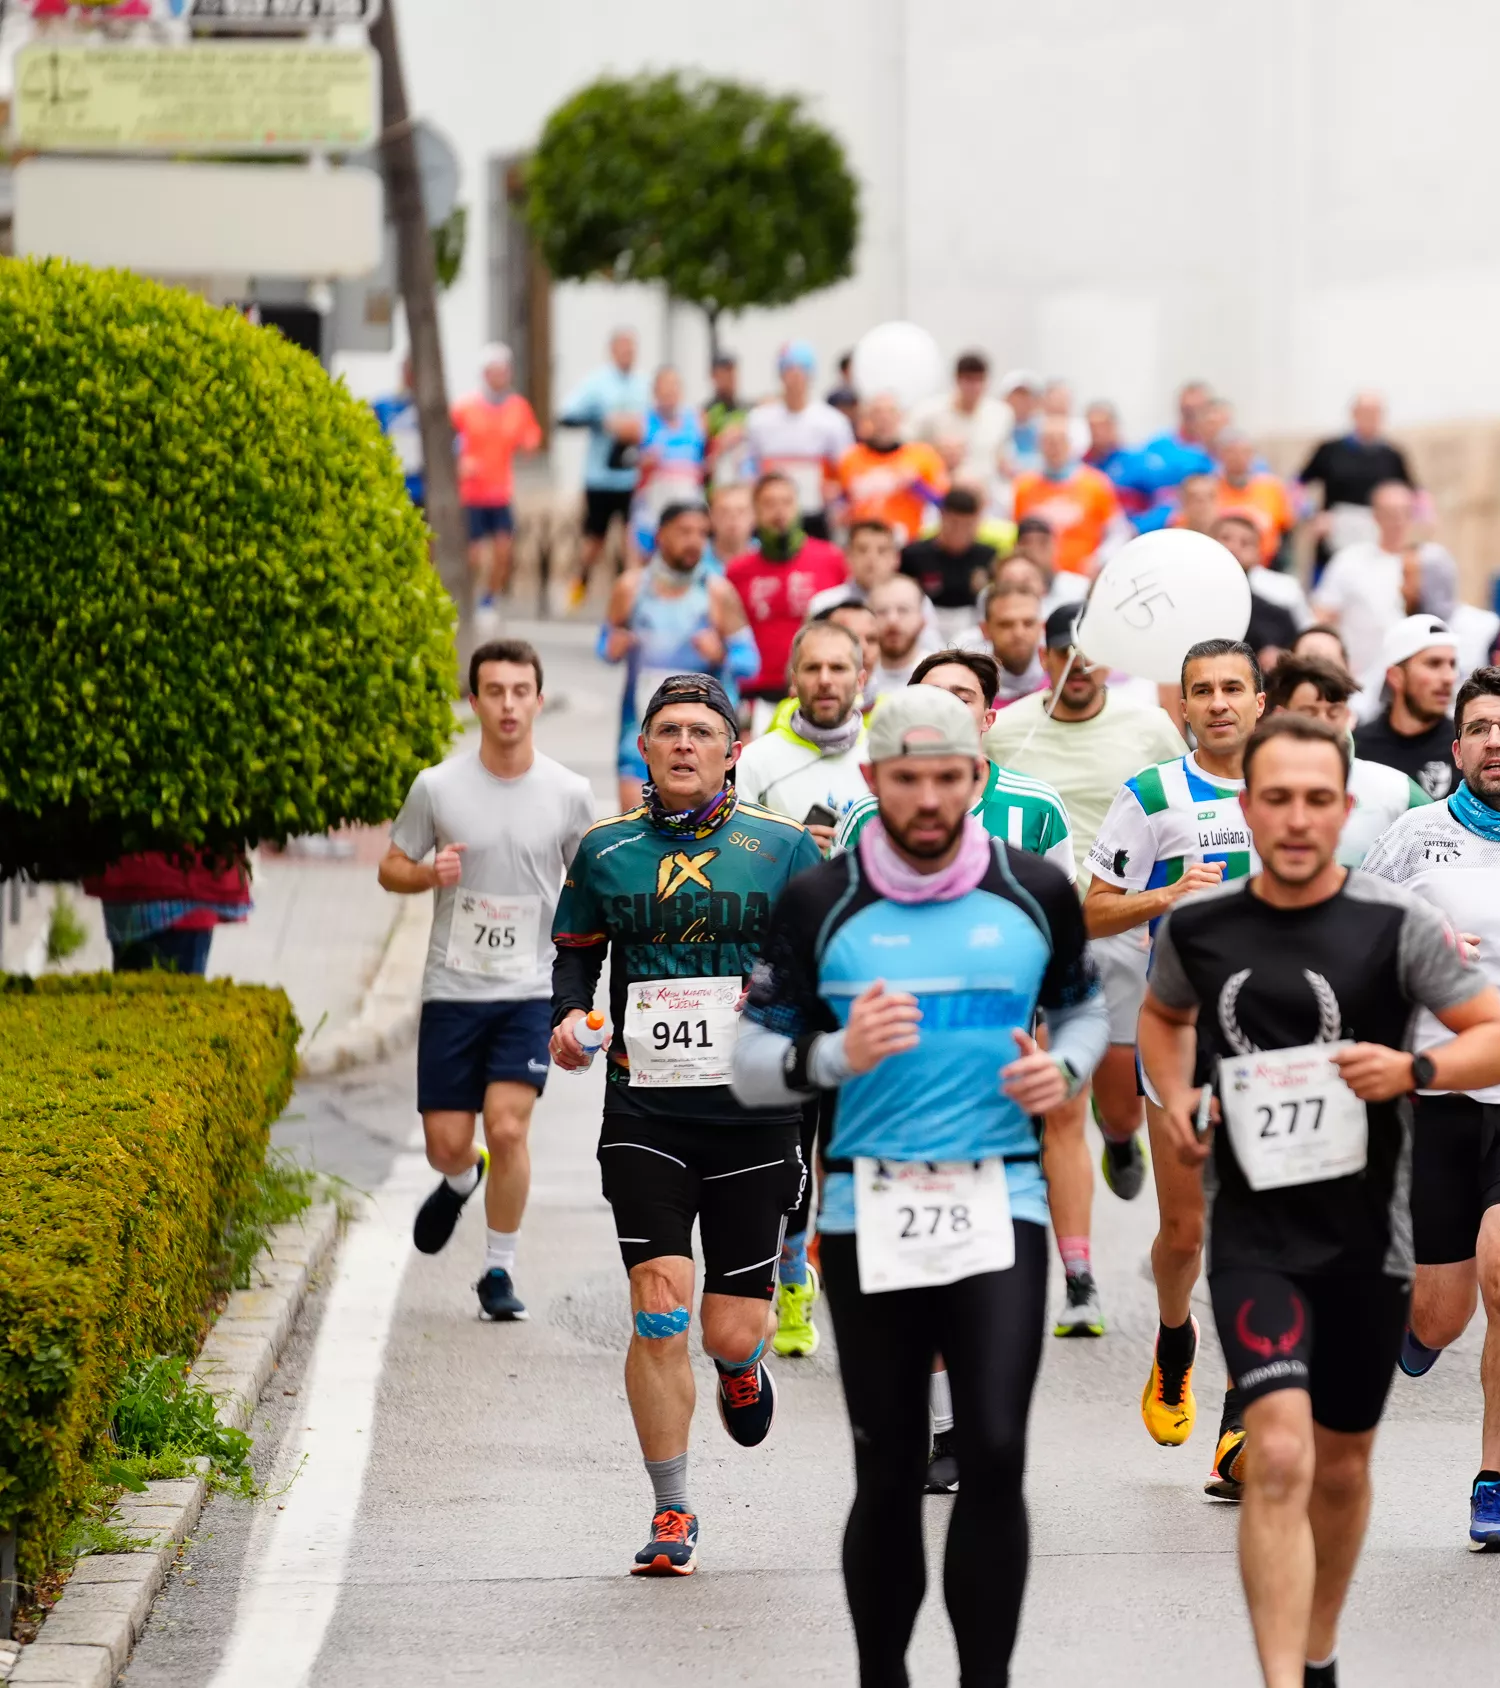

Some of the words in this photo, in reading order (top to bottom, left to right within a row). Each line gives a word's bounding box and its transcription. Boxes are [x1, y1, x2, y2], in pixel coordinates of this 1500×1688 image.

[728, 831, 761, 852] SIG
[1198, 832, 1209, 847] La
[1210, 828, 1245, 846] Luisiana
[1424, 840, 1459, 848] CAFETERIA
[656, 847, 721, 903] IX
[611, 890, 770, 932] SUBIDA
[474, 924, 516, 948] 765
[652, 932, 667, 943] a
[680, 917, 716, 943] las
[669, 1000, 704, 1009] LUCENA
[652, 1020, 713, 1050] 941
[1256, 1096, 1326, 1138] 277
[898, 1204, 972, 1239] 278
